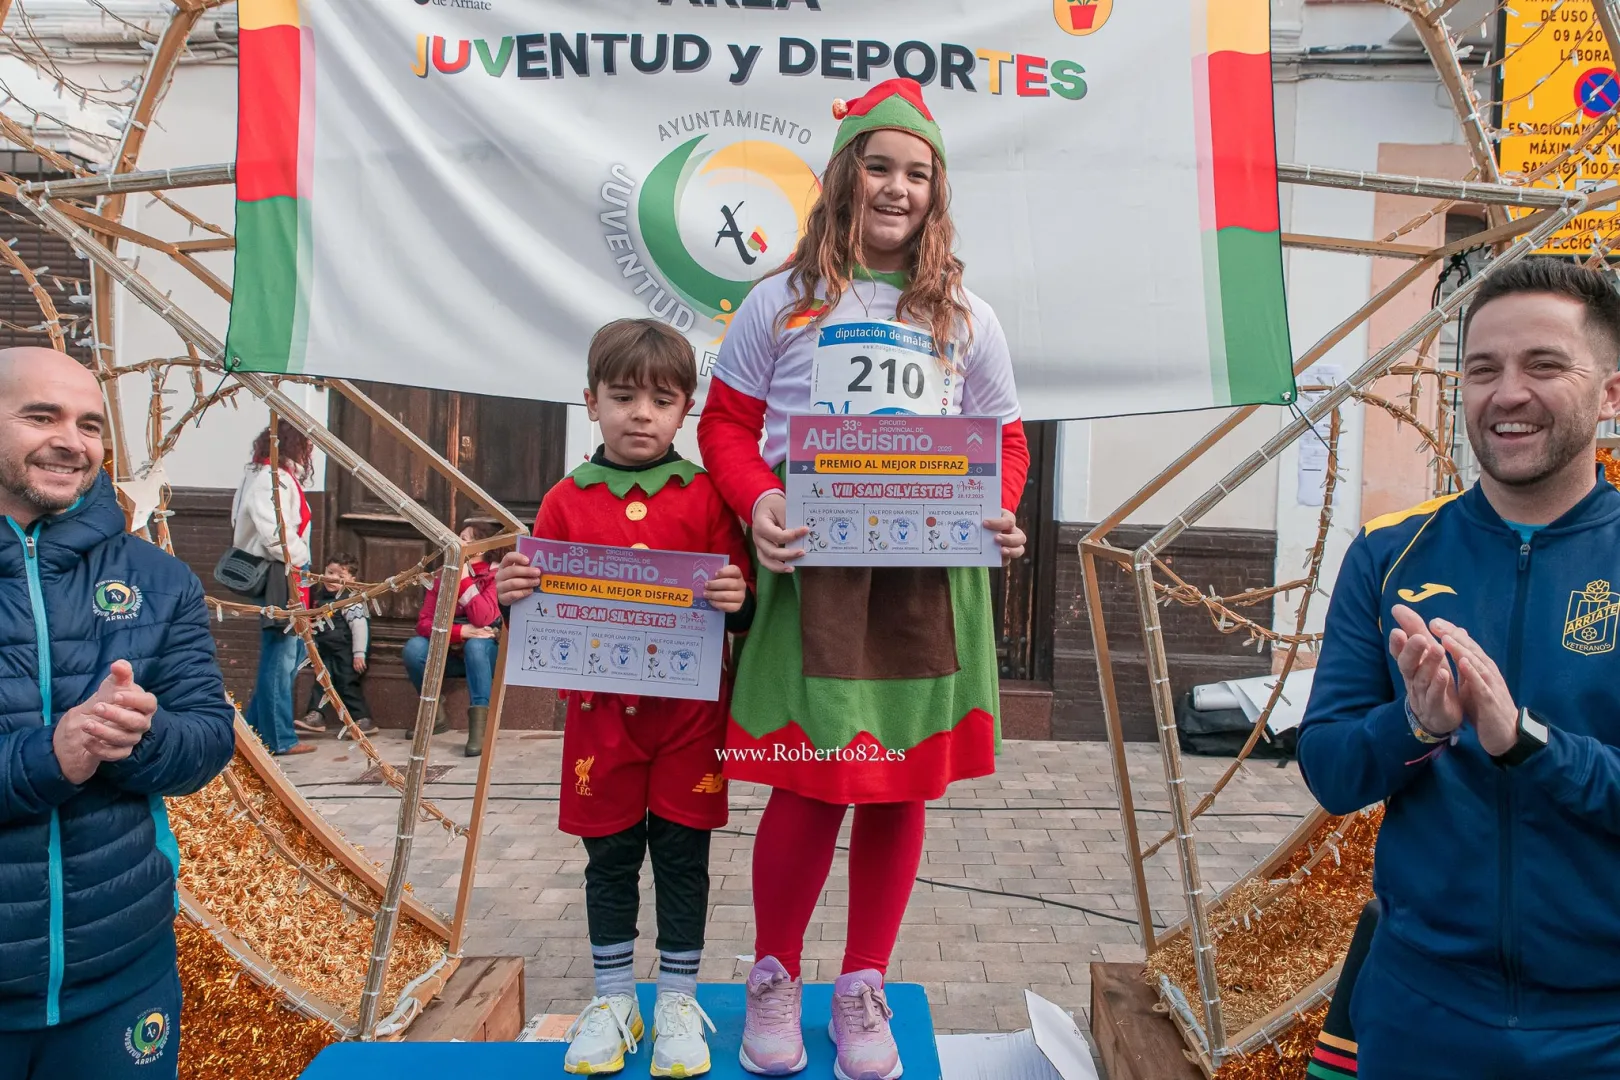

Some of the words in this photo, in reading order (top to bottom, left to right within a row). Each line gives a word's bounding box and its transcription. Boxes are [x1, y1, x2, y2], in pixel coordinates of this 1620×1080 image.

[1561, 10, 1588, 22] USO
[1554, 29, 1570, 42] 09
[1574, 30, 1582, 42] A
[1587, 30, 1603, 42] 20
[1560, 49, 1614, 62] LABORA
[409, 32, 712, 79] JUVENTUD
[727, 43, 763, 86] y
[779, 36, 1088, 100] DEPORTES
[658, 109, 812, 145] AYUNTAMIENTO
[1522, 159, 1578, 174] SAIÓ
[1585, 162, 1608, 174] 100
[599, 163, 695, 333] JUVENTUD
[835, 327, 886, 339] diputación
[889, 330, 901, 341] de
[903, 334, 935, 352] málag
[847, 355, 925, 400] 210
[803, 428, 933, 453] Atletismo
[820, 459, 862, 470] PREMIO
[865, 460, 879, 470] AL
[881, 460, 917, 472] MEJOR
[920, 461, 964, 471] DISFRAZ
[832, 483, 854, 498] VIII
[856, 483, 885, 499] SAN
[886, 483, 953, 499] SILVESTRE
[605, 549, 634, 557] CIRCUITO
[606, 555, 639, 563] PROVINCIAL
[530, 550, 660, 582] Atletismo
[545, 580, 588, 592] PREMIO
[590, 584, 604, 594] AL
[607, 586, 642, 598] MEJOR
[645, 589, 689, 602] DISFRAZ
[105, 612, 139, 622] ARRIATE
[557, 603, 579, 619] VIII
[580, 605, 609, 622] SAN
[609, 609, 676, 628] SILVESTRE
[1567, 604, 1618, 632] ARRIATE
[1566, 640, 1612, 652] VETERANOS
[124, 1026, 142, 1059] JUVENTUD
[134, 1050, 164, 1065] ARRIATE
